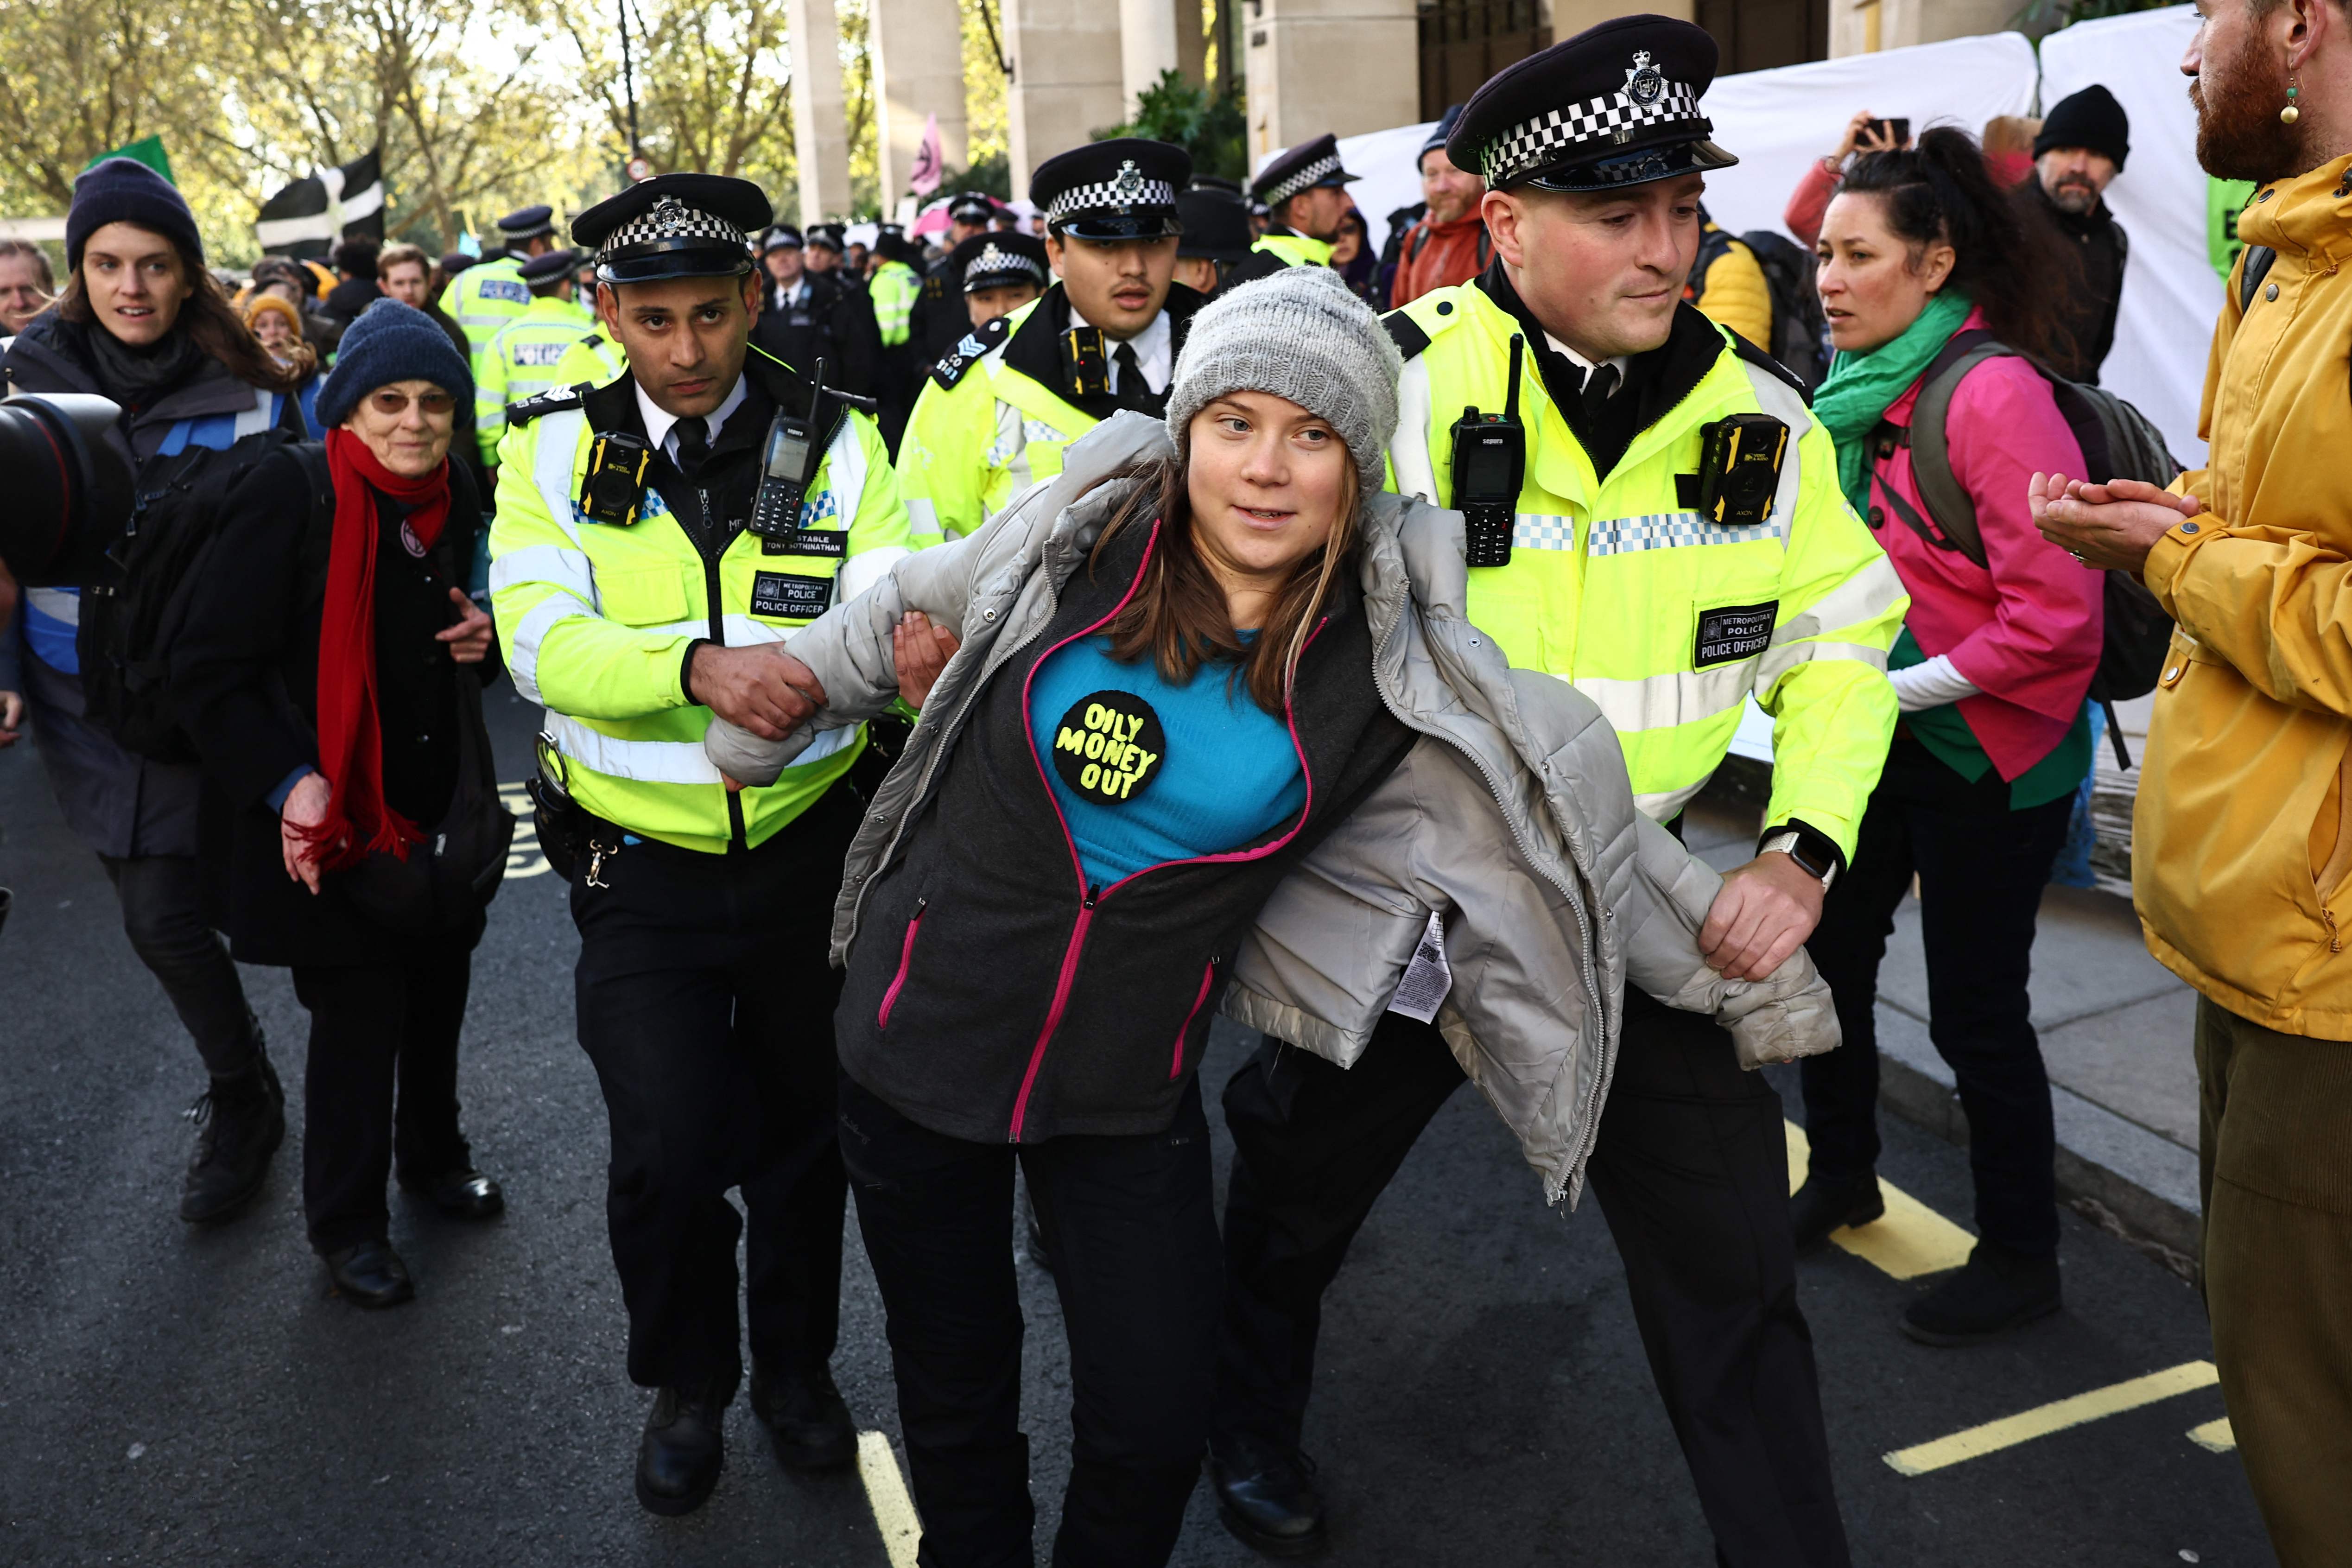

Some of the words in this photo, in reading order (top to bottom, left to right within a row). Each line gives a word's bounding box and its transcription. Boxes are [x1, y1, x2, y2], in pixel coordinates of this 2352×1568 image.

[788, 590, 817, 599] POLICE
[755, 601, 788, 612] POLICE
[790, 604, 824, 613] OFFICER
[1723, 613, 1771, 625] METROPOLITAN
[1728, 624, 1763, 635] POLICE
[1702, 642, 1731, 659] POLICE
[1734, 636, 1768, 653] OFFICER
[1084, 703, 1144, 743] OILY
[1056, 727, 1157, 778] MONEY
[1080, 763, 1138, 799] OUT
